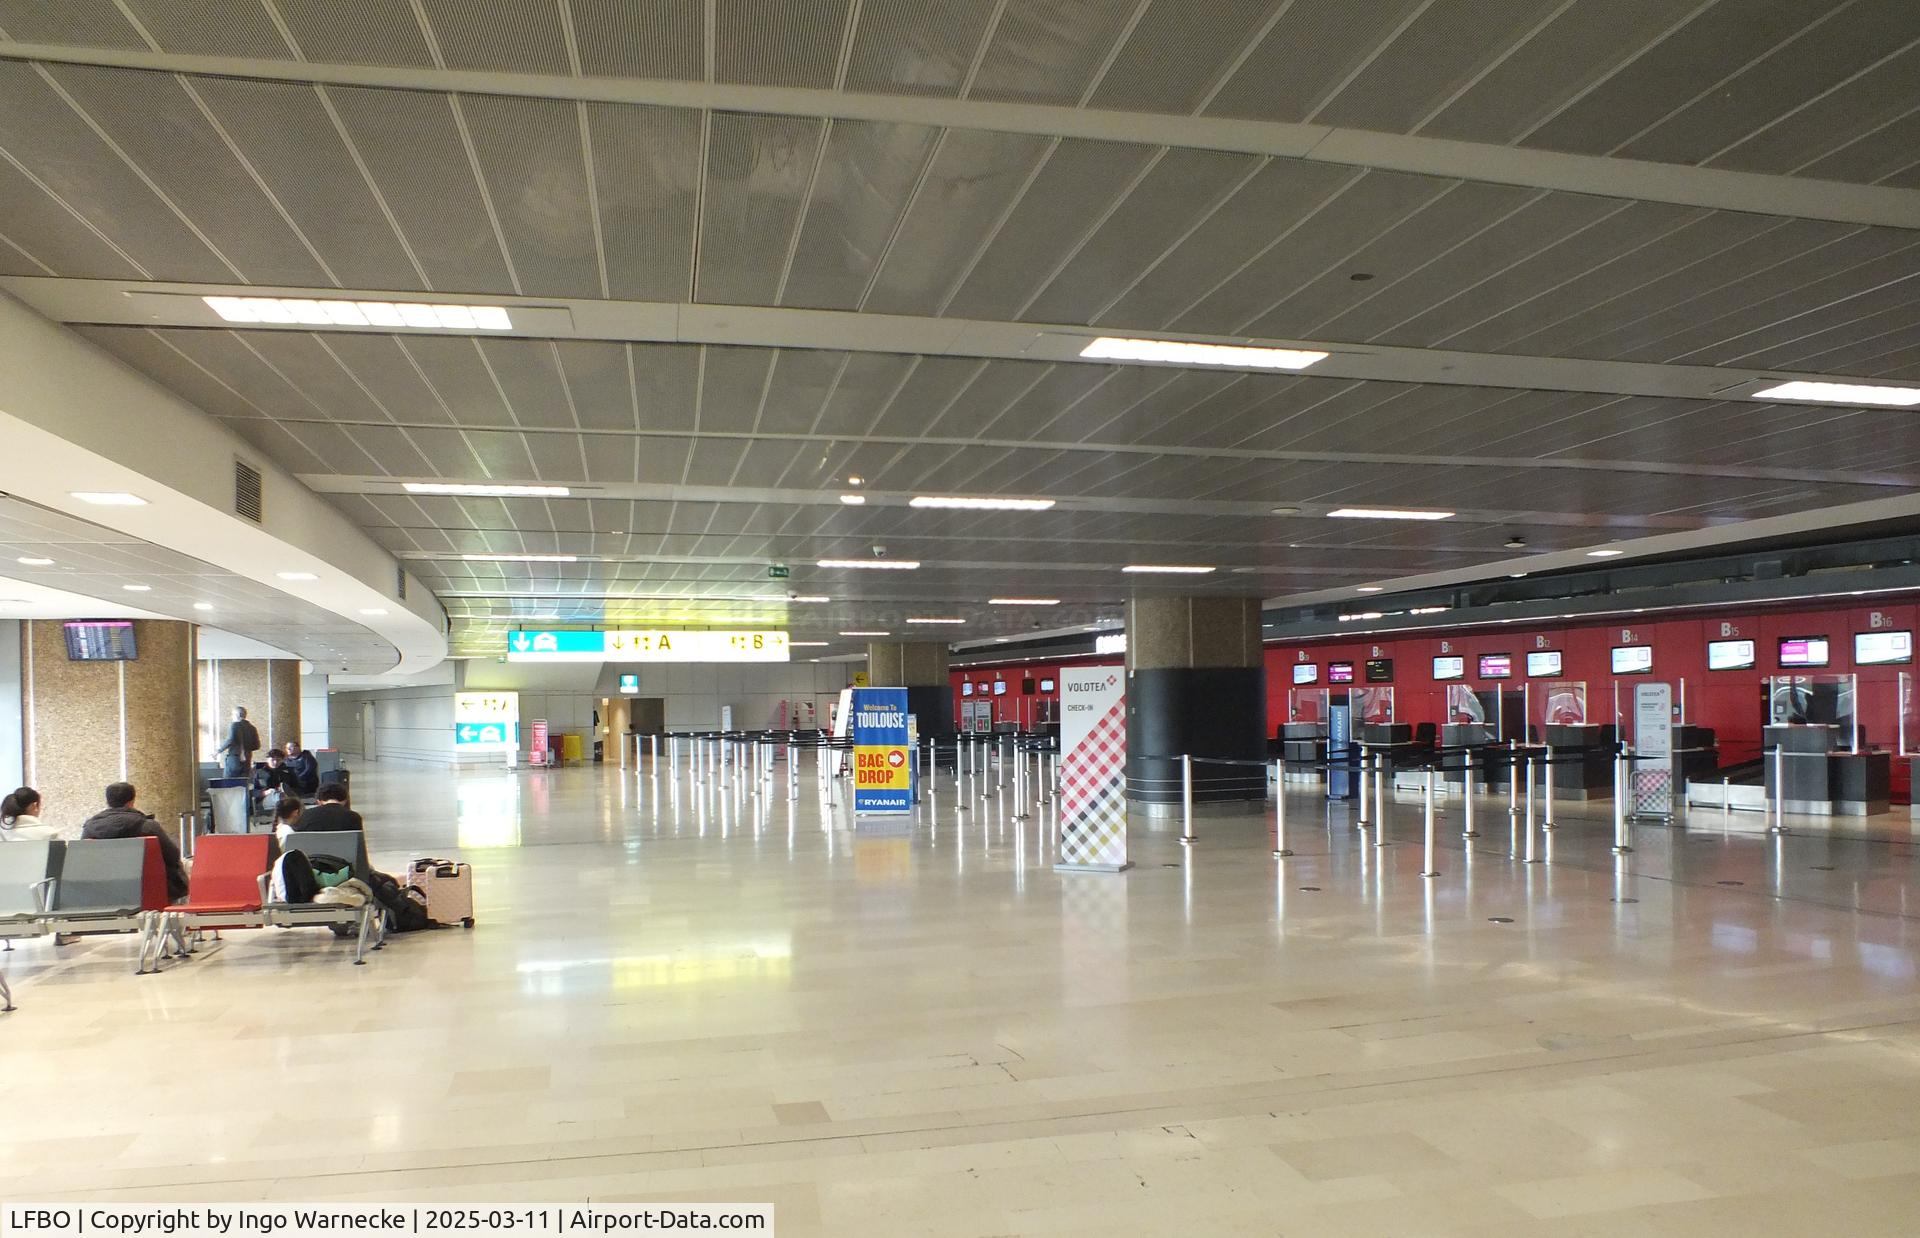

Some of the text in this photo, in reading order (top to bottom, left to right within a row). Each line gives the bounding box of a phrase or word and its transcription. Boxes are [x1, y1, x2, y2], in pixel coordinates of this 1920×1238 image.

[1870, 611, 1893, 628] B16
[1621, 629, 1638, 643] B14
[1720, 622, 1740, 637] B15
[658, 634, 671, 650] A
[753, 634, 763, 649] B
[1067, 682, 1107, 692] VOLOTEA
[1067, 704, 1094, 712] CHECK-IN
[856, 712, 905, 728] TOULOUSE
[858, 753, 885, 768] BAG
[858, 769, 894, 784] DROP
